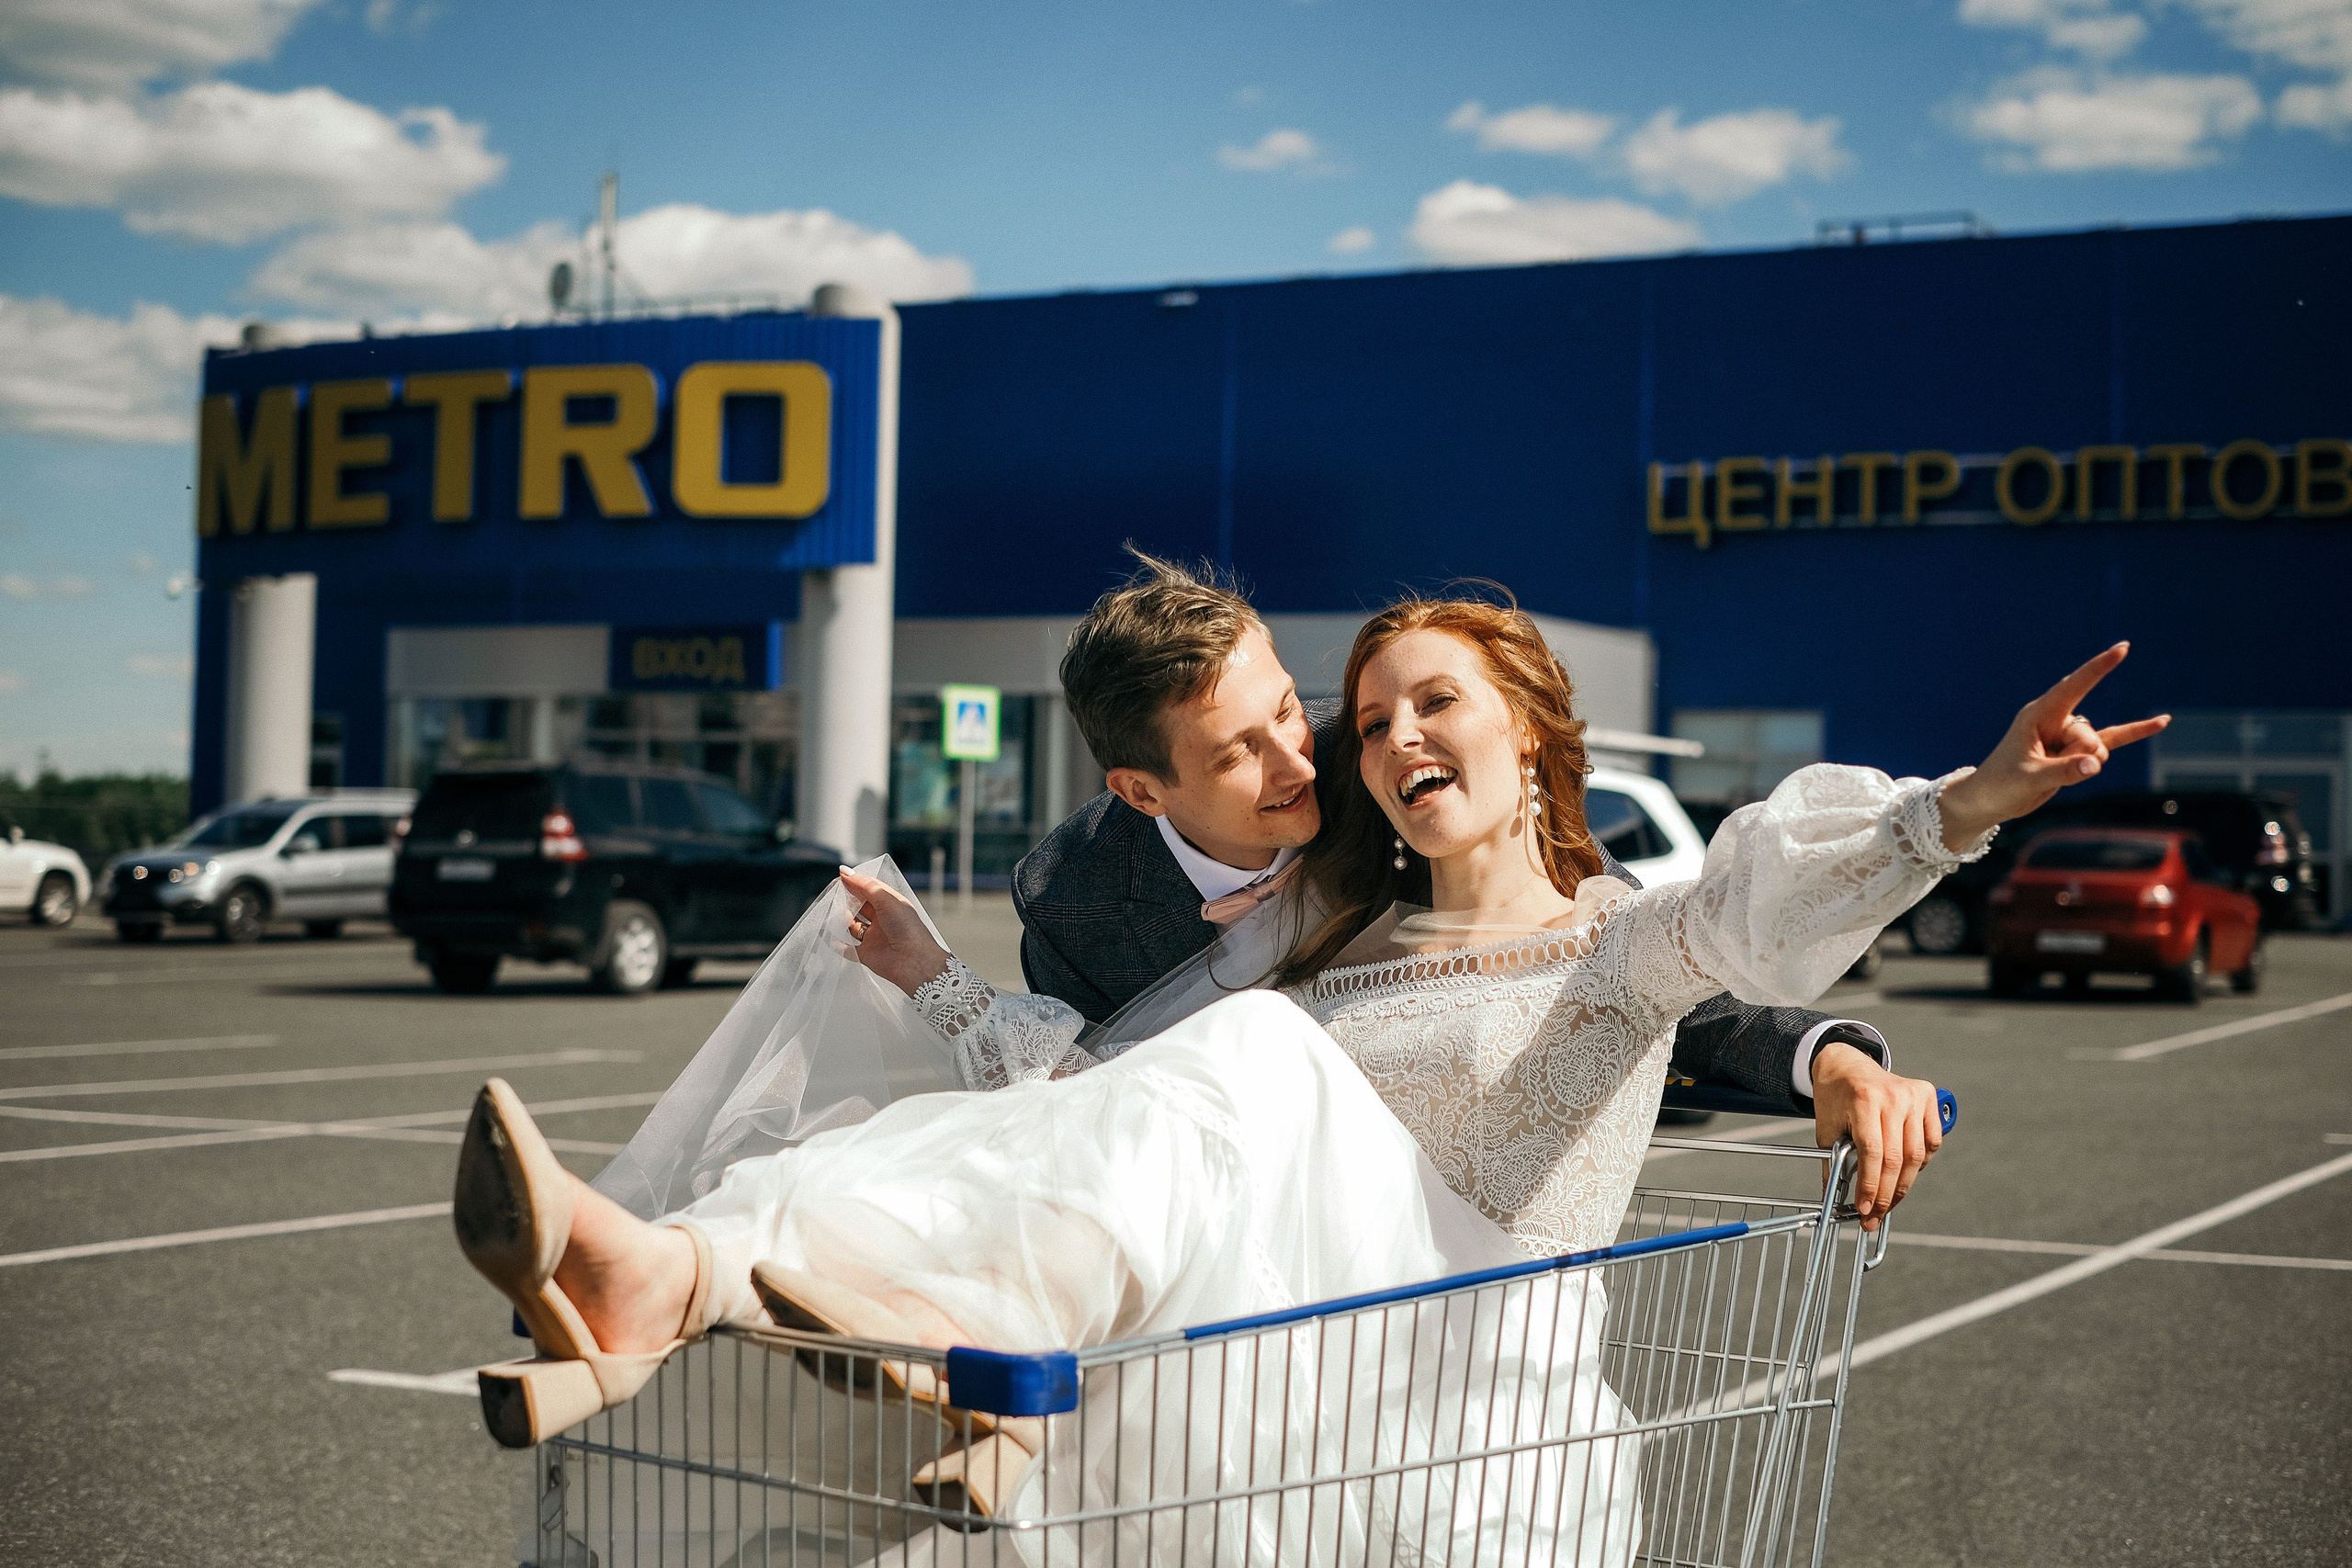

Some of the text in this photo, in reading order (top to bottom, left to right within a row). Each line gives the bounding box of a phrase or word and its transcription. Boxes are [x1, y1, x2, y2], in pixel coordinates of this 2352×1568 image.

[198, 359, 833, 536] METRO
[1647, 438, 2352, 549] ЦЕНТР ОПТОВ
[632, 637, 745, 682] ВХОД
